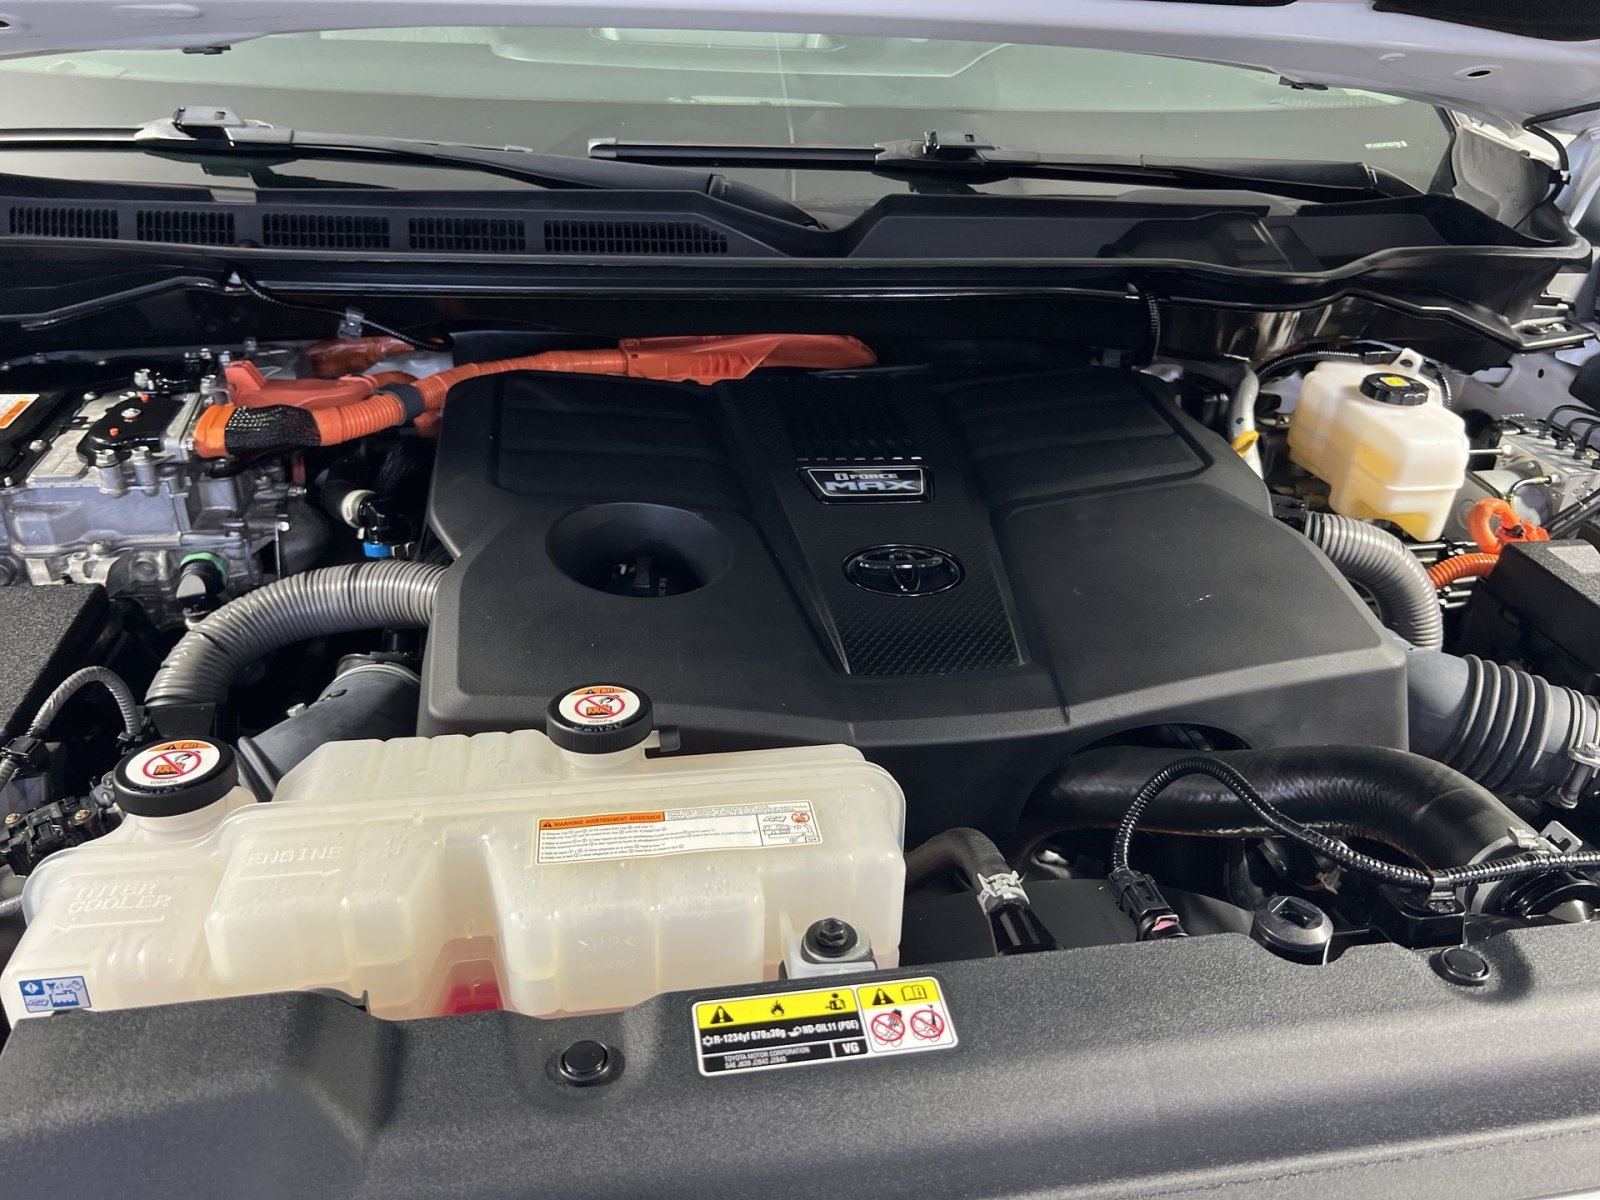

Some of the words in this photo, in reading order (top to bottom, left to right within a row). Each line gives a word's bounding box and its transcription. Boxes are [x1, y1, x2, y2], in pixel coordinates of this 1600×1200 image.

[824, 480, 919, 491] MAX
[554, 819, 584, 827] WARNING
[585, 816, 627, 824] AVERTISSEMENT
[247, 845, 343, 866] ENGINE
[76, 882, 158, 898] INTER
[67, 895, 172, 914] COOLER
[838, 1019, 859, 1032] (POE)
[724, 1054, 747, 1062] TOYOTA
[747, 1051, 769, 1060] MOTOR
[769, 1047, 810, 1057] CORPORATION
[842, 1042, 860, 1054] VG
[724, 1062, 736, 1070] SAE
